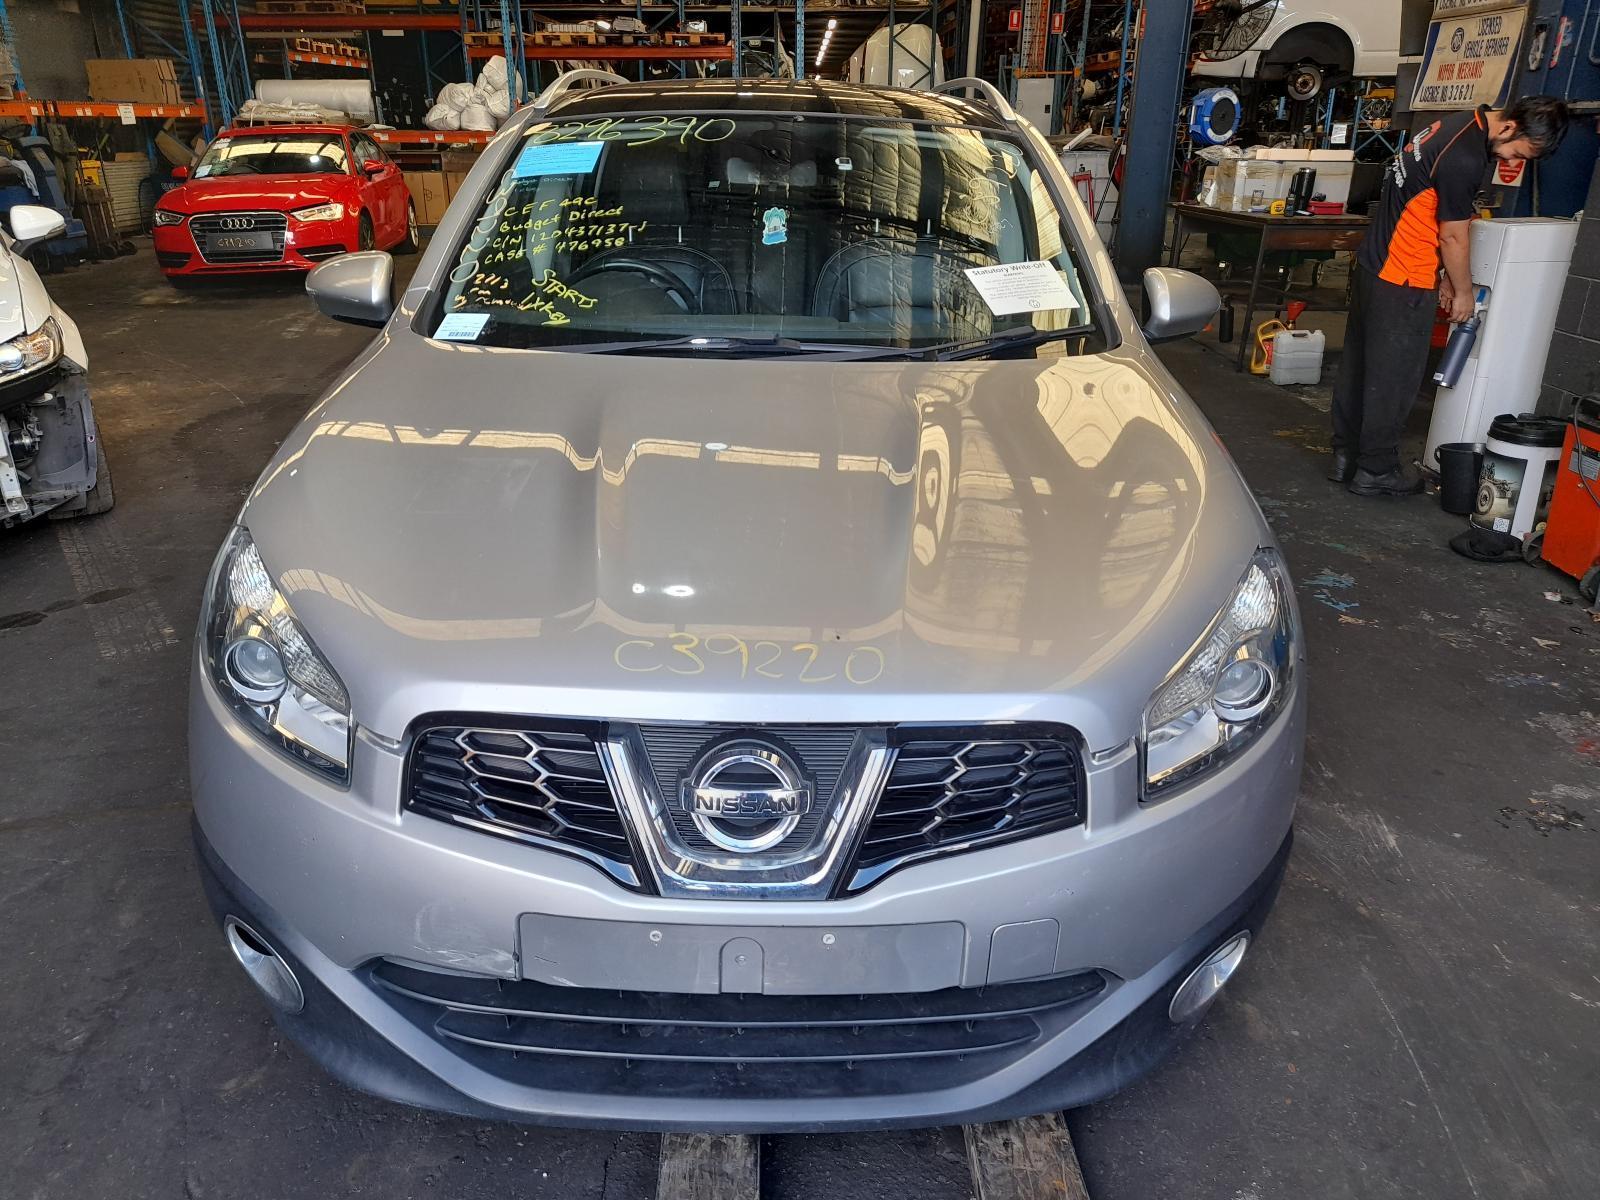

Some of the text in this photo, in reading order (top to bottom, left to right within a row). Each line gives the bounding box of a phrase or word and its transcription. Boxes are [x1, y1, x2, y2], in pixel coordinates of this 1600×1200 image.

[1463, 36, 1509, 59] VEHICLE REPAIRER
[1436, 60, 1484, 81] MOTOR MECHANIC
[1448, 83, 1474, 101] 32621
[499, 205, 624, 233] Budget Direct
[972, 265, 1009, 276] Statutory
[614, 632, 886, 684] C39220
[695, 794, 796, 814] NISSAN
